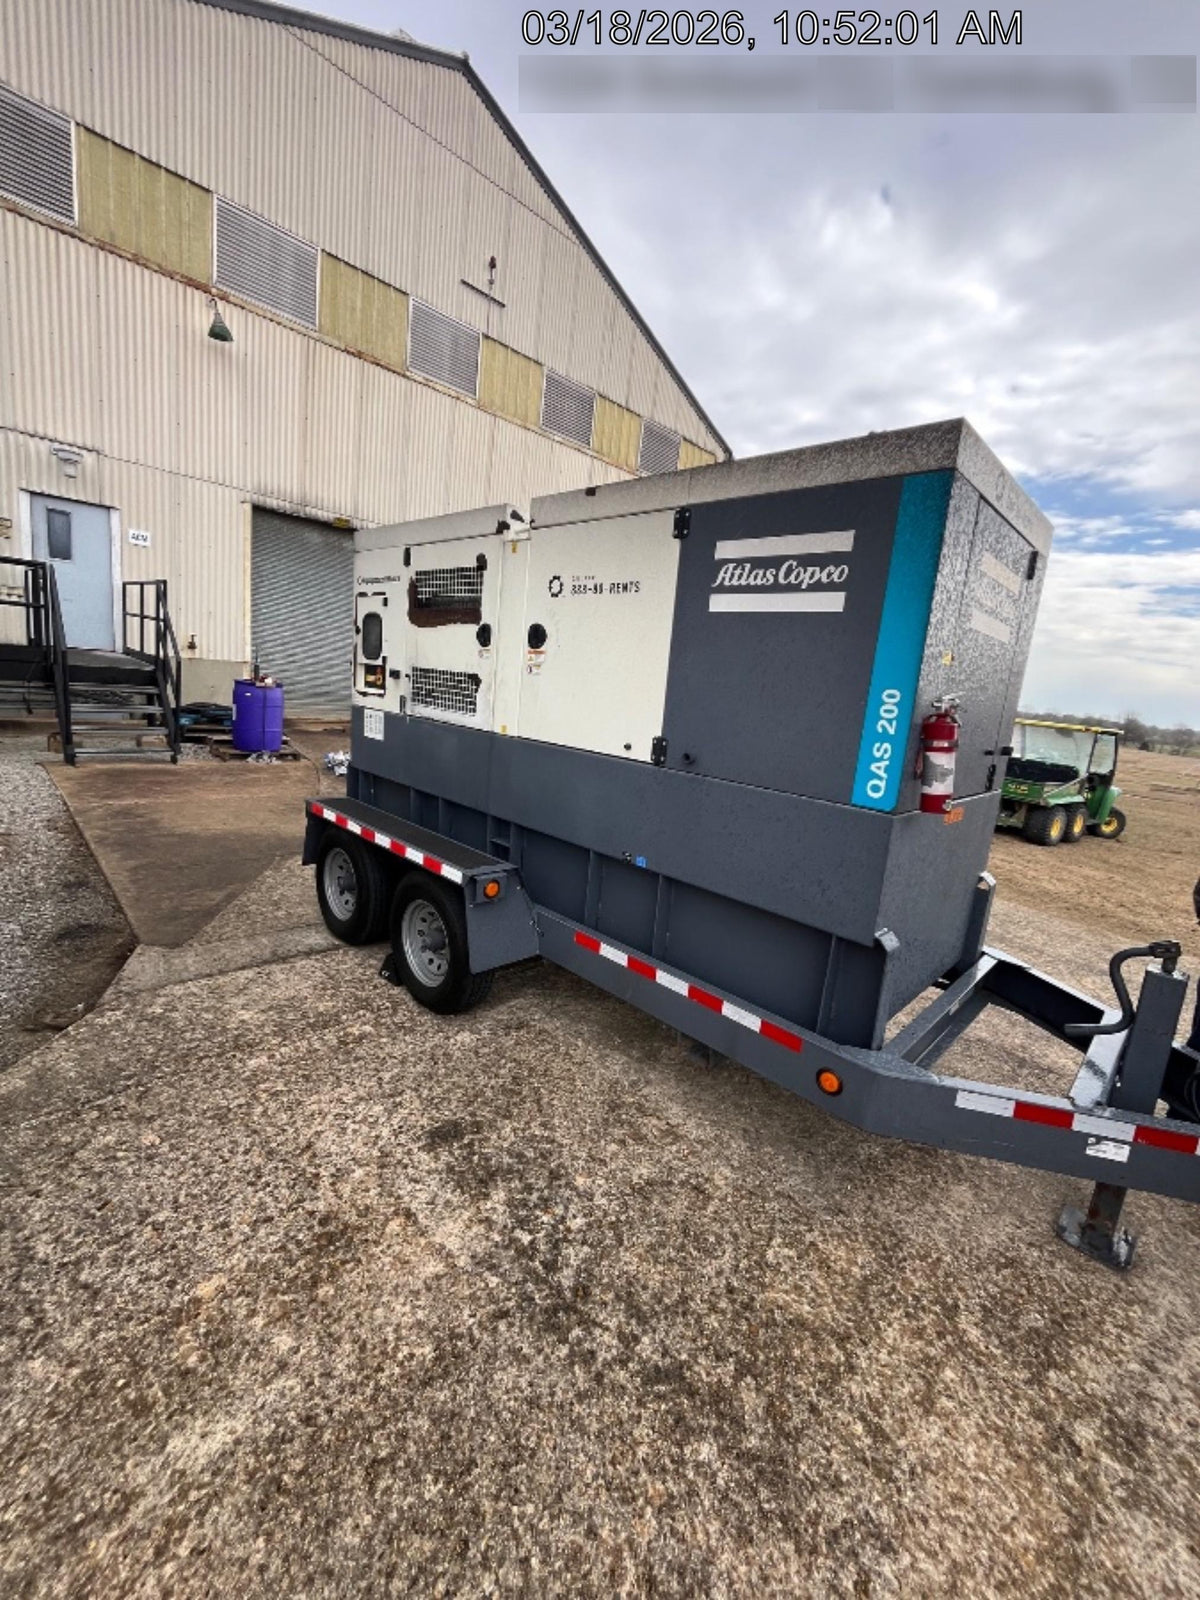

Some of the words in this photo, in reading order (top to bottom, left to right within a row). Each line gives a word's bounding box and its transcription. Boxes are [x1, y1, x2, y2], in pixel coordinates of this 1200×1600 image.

[711, 562, 776, 588] Atlas
[778, 559, 849, 589] Copco
[876, 689, 901, 735] 200
[866, 742, 892, 799] QAS
